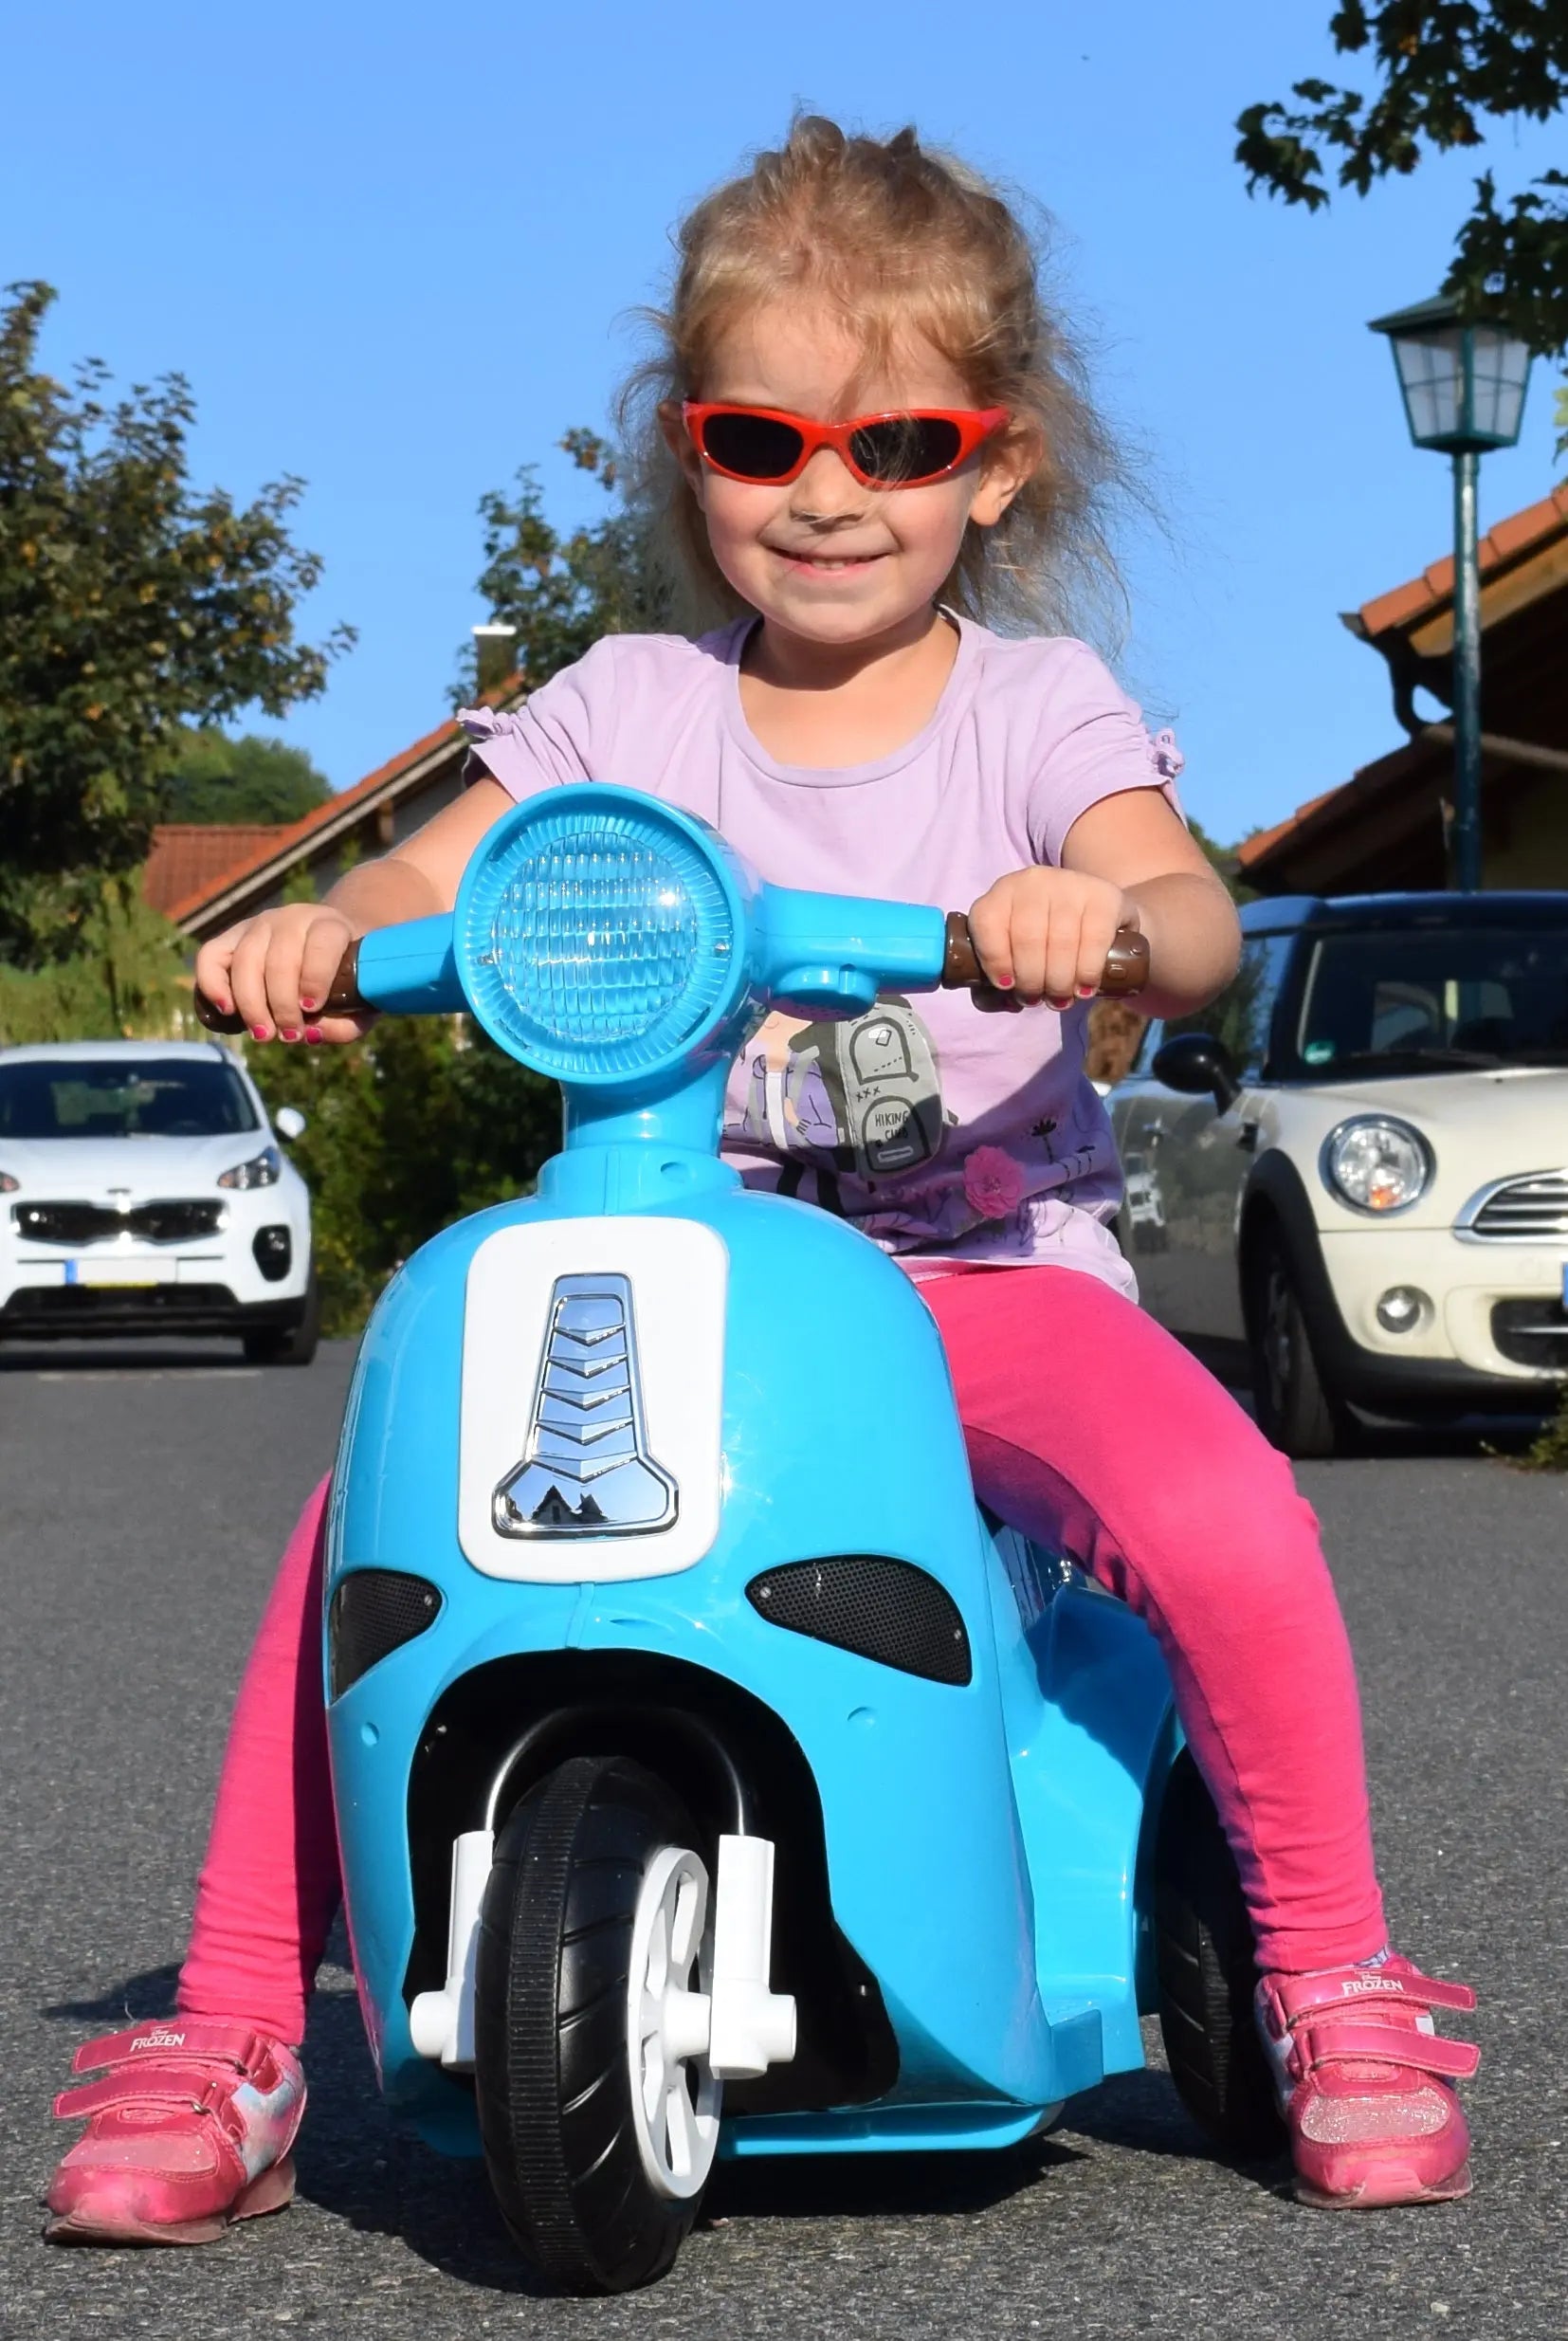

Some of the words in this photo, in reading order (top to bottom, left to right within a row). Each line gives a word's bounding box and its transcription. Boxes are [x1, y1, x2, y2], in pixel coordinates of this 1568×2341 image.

[874, 1110, 909, 1127] HIKING
[1340, 1979, 1404, 1997] FROZEN
[129, 2033, 186, 2053] FROZEN
